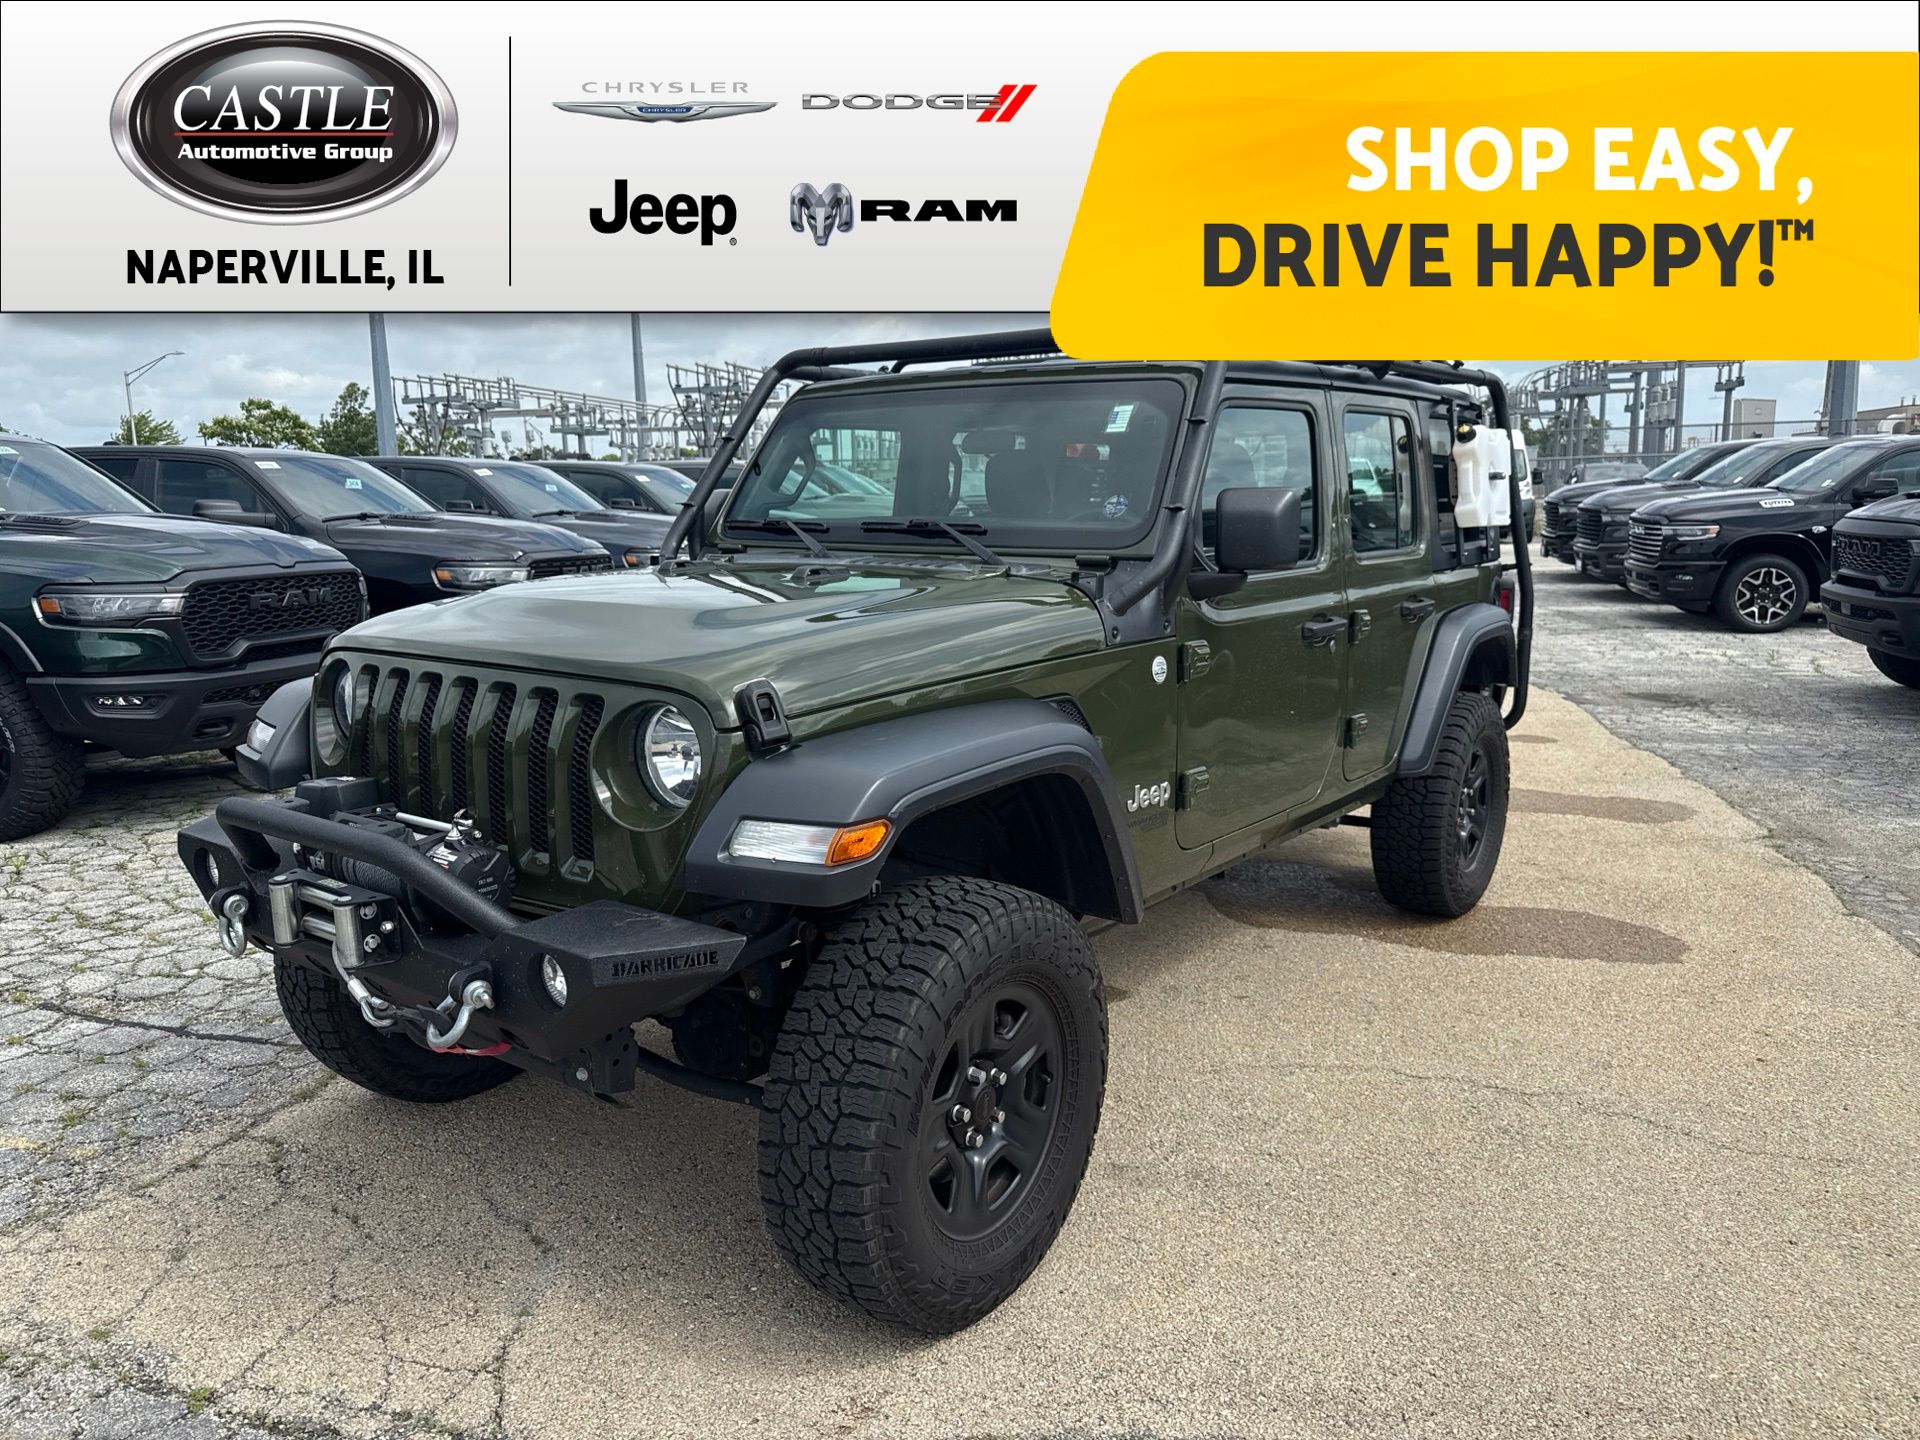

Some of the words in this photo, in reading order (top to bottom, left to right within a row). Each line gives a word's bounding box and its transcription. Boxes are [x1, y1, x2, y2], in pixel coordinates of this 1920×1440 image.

[1839, 537, 1880, 556] RAM
[249, 587, 331, 610] RAM
[1127, 781, 1171, 812] Jeep
[612, 950, 719, 977] BARRICADE
